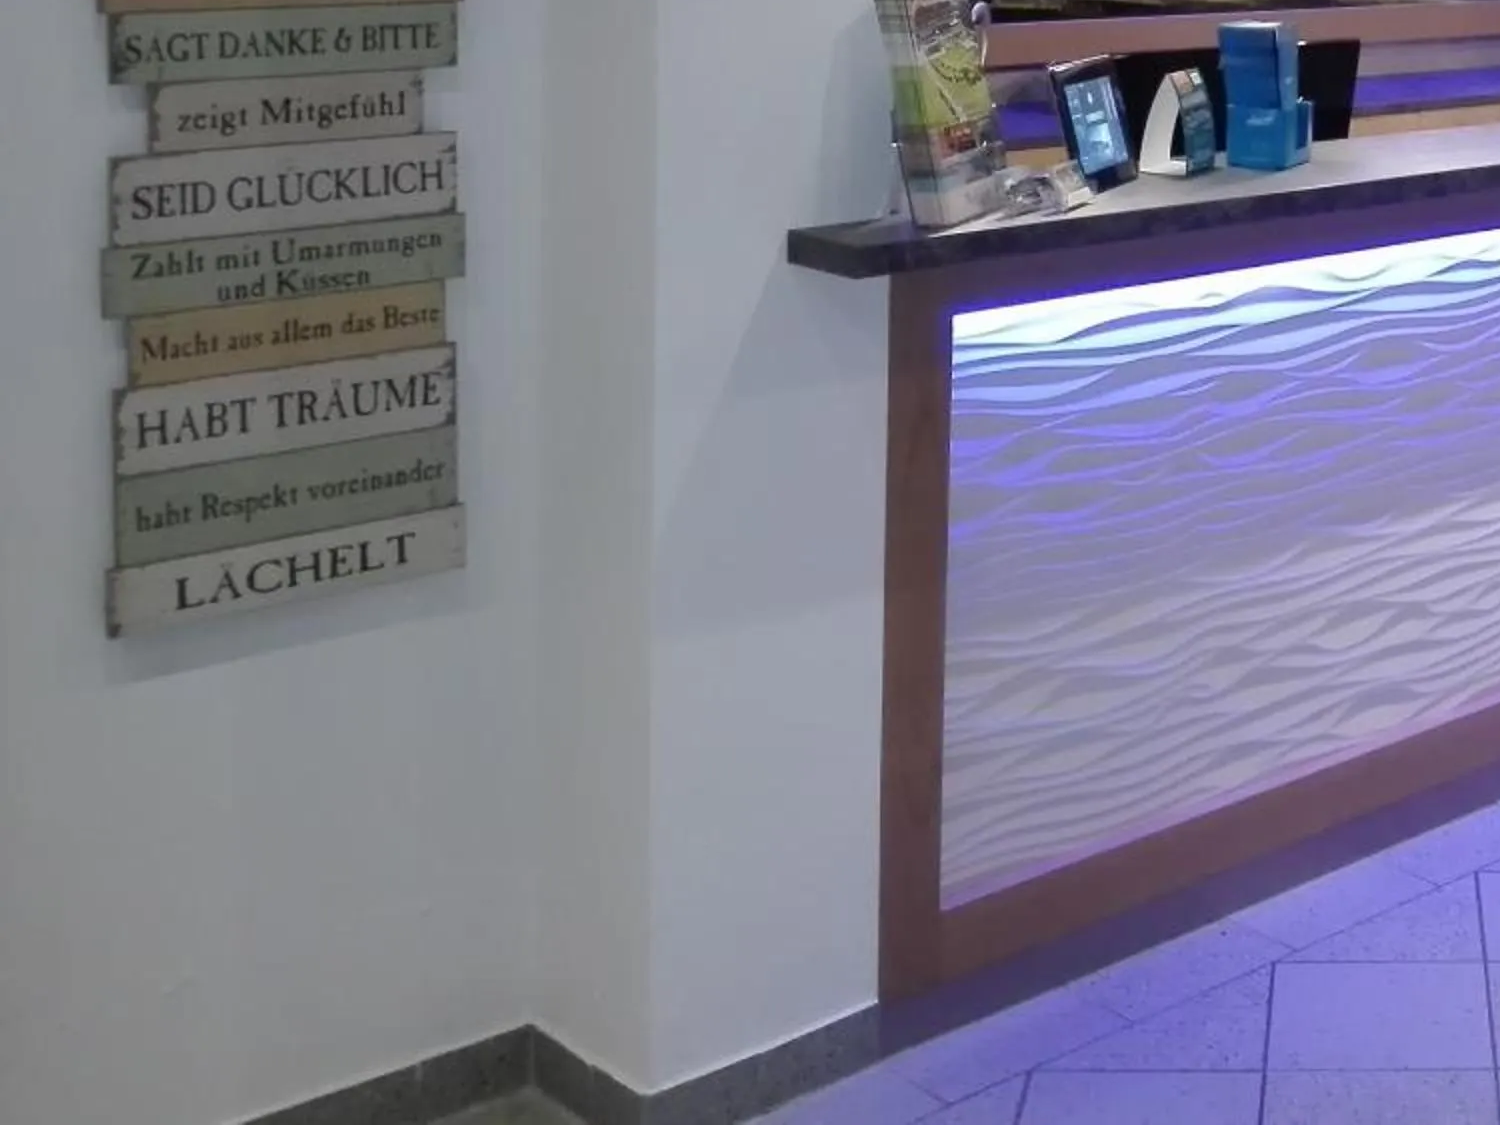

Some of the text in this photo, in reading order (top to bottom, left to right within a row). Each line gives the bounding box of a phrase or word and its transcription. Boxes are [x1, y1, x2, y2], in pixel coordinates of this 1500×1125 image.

[124, 22, 442, 65] SAGT DANKE & BITTE
[177, 90, 406, 136] zeigt Mitgefühl
[131, 181, 216, 220] SEID
[130, 232, 443, 282] Zahlt mit Umarmungen
[217, 275, 266, 302] und
[141, 305, 440, 363] Macht aus allem das Beste
[135, 375, 443, 449] HABT TRÄUME
[135, 458, 446, 533] habt Respekt voreinander
[175, 532, 416, 610] LÄCHELT
